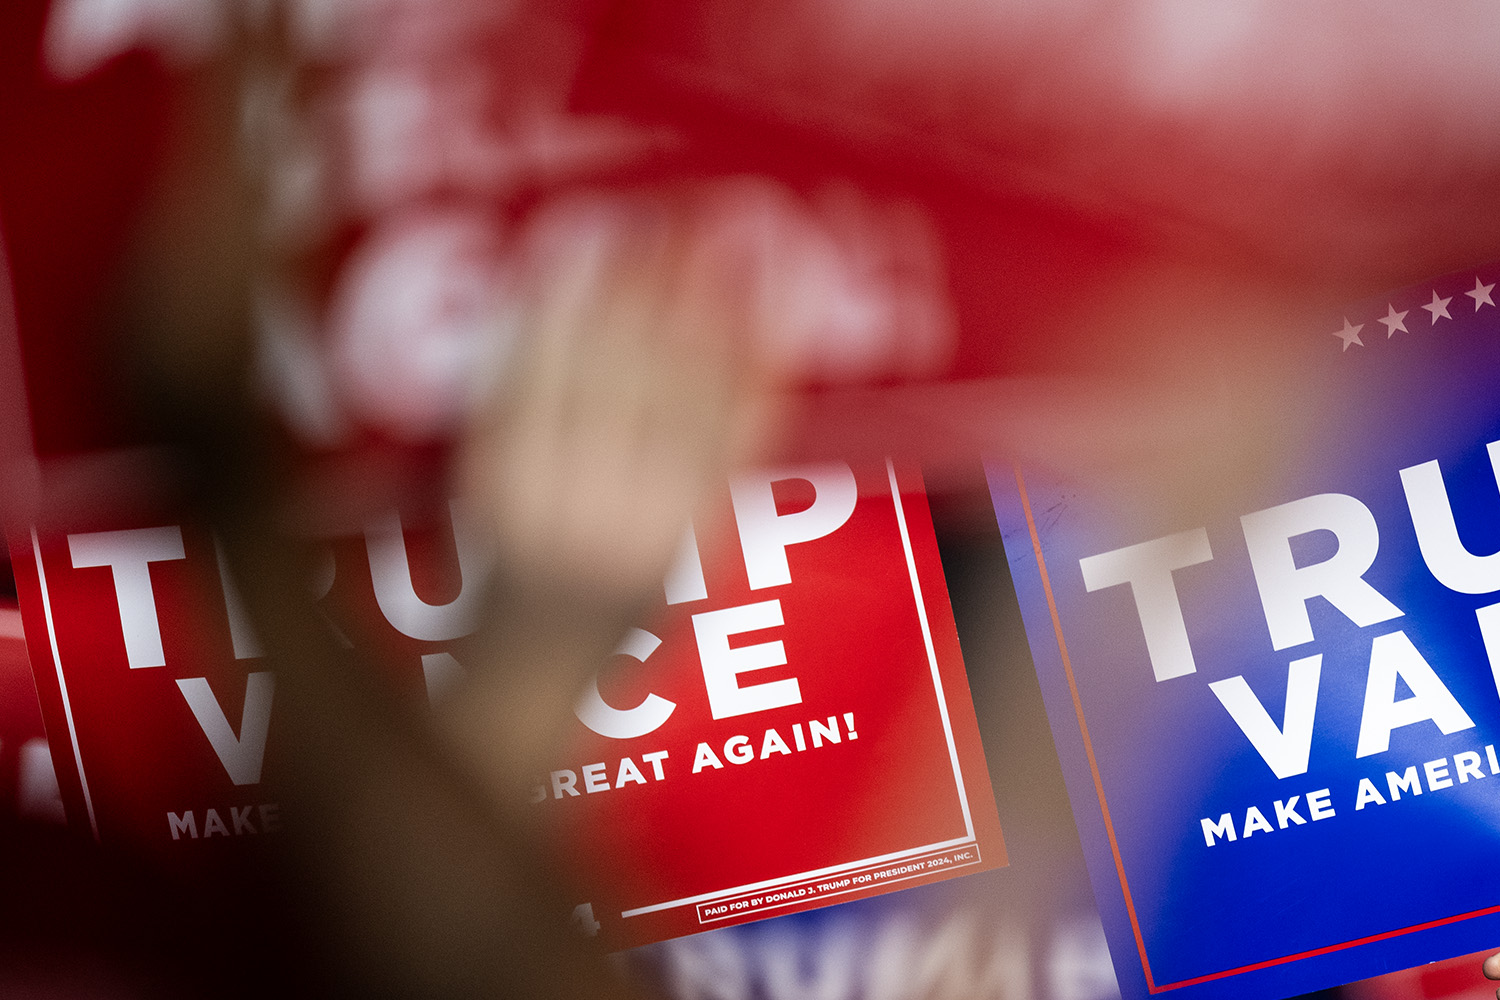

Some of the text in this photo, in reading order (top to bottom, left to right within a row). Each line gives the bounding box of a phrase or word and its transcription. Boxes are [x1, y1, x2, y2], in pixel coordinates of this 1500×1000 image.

[166, 802, 284, 841] MAKE
[691, 711, 859, 774] AGAIN!
[1200, 788, 1337, 847] MAKE
[705, 851, 974, 916] PAID FOR BY DONALD J. TRUMP FOR PRESIDENT 2024, INC.
